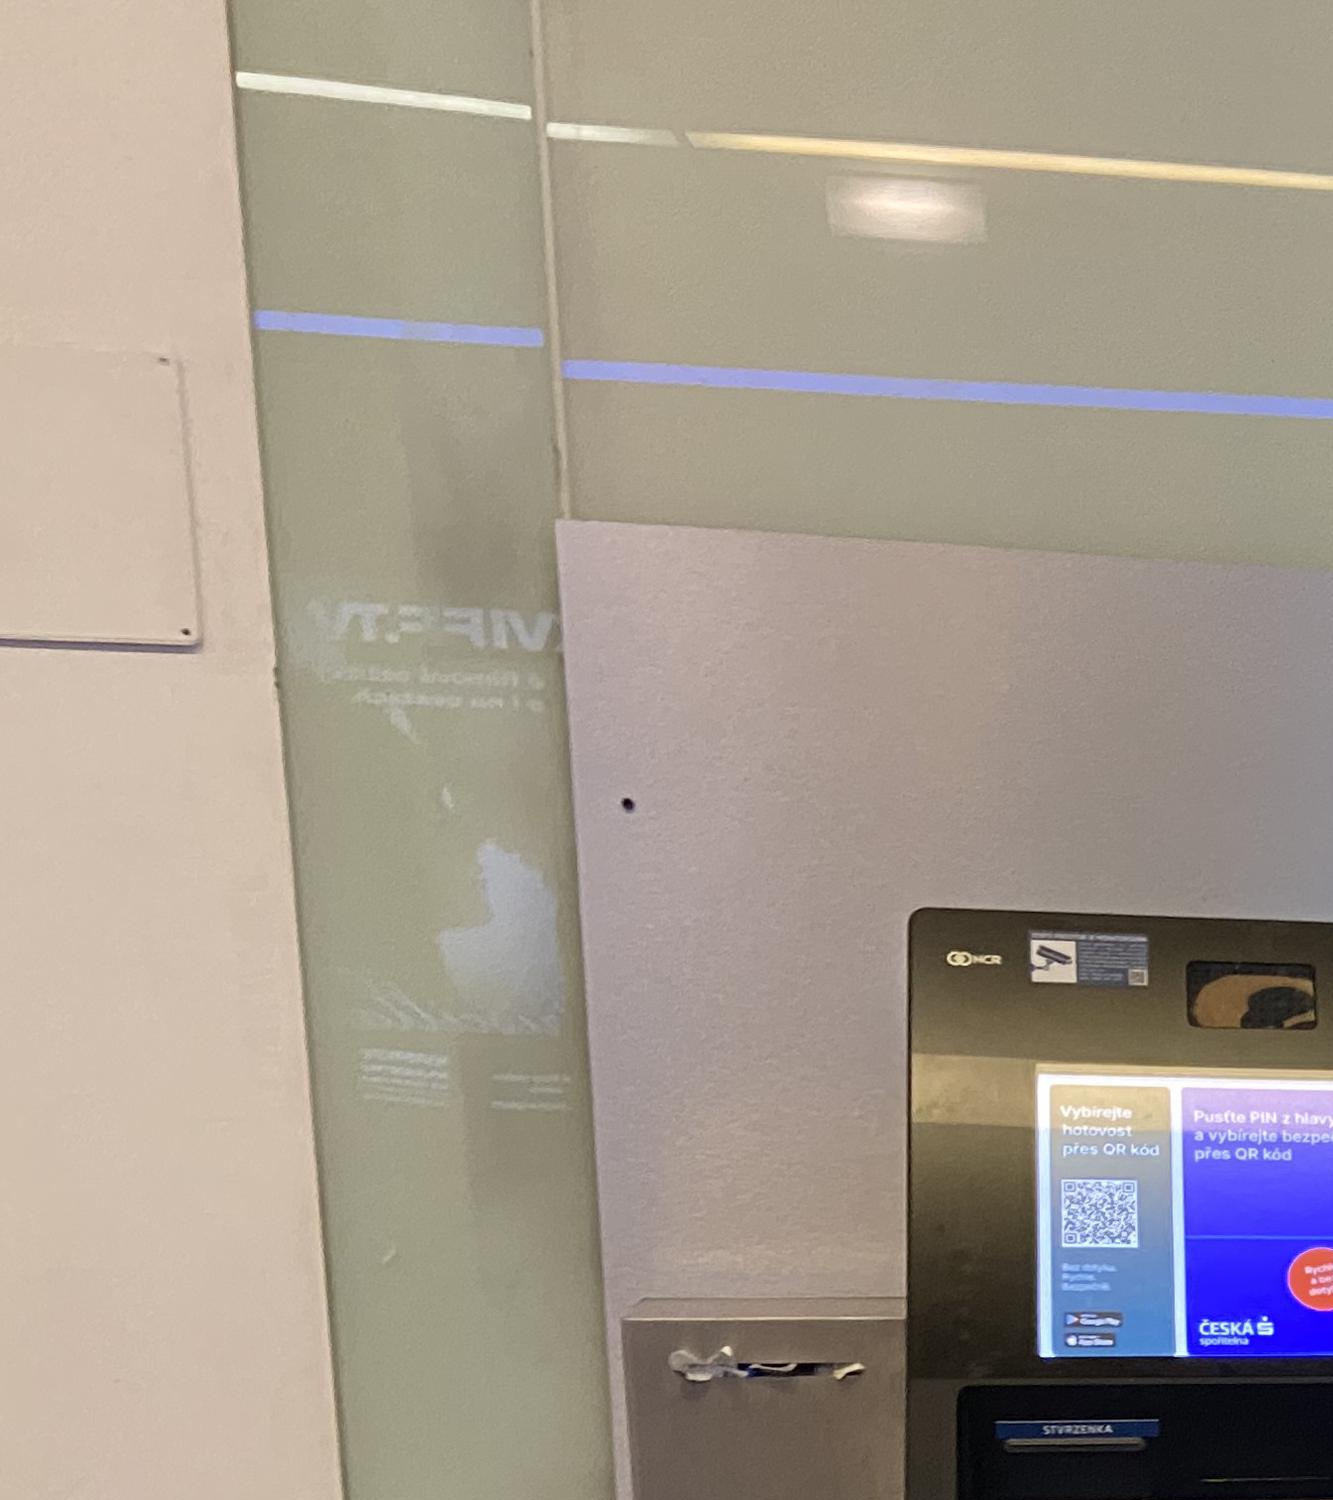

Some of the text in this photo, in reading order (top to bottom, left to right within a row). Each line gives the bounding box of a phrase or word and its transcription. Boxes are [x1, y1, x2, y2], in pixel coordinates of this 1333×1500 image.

[1060, 1105, 1133, 1121] Vybírejte
[1250, 1111, 1278, 1125] PIN
[1282, 1113, 1291, 1125] z
[1063, 1124, 1133, 1137] hotovost
[1194, 1131, 1204, 1142] a
[1208, 1129, 1278, 1145] vybírejte
[1063, 1142, 1160, 1157] přes QR kód
[1195, 1147, 1292, 1162] přes QR kód
[1199, 1319, 1255, 1336] ČESKÁ
